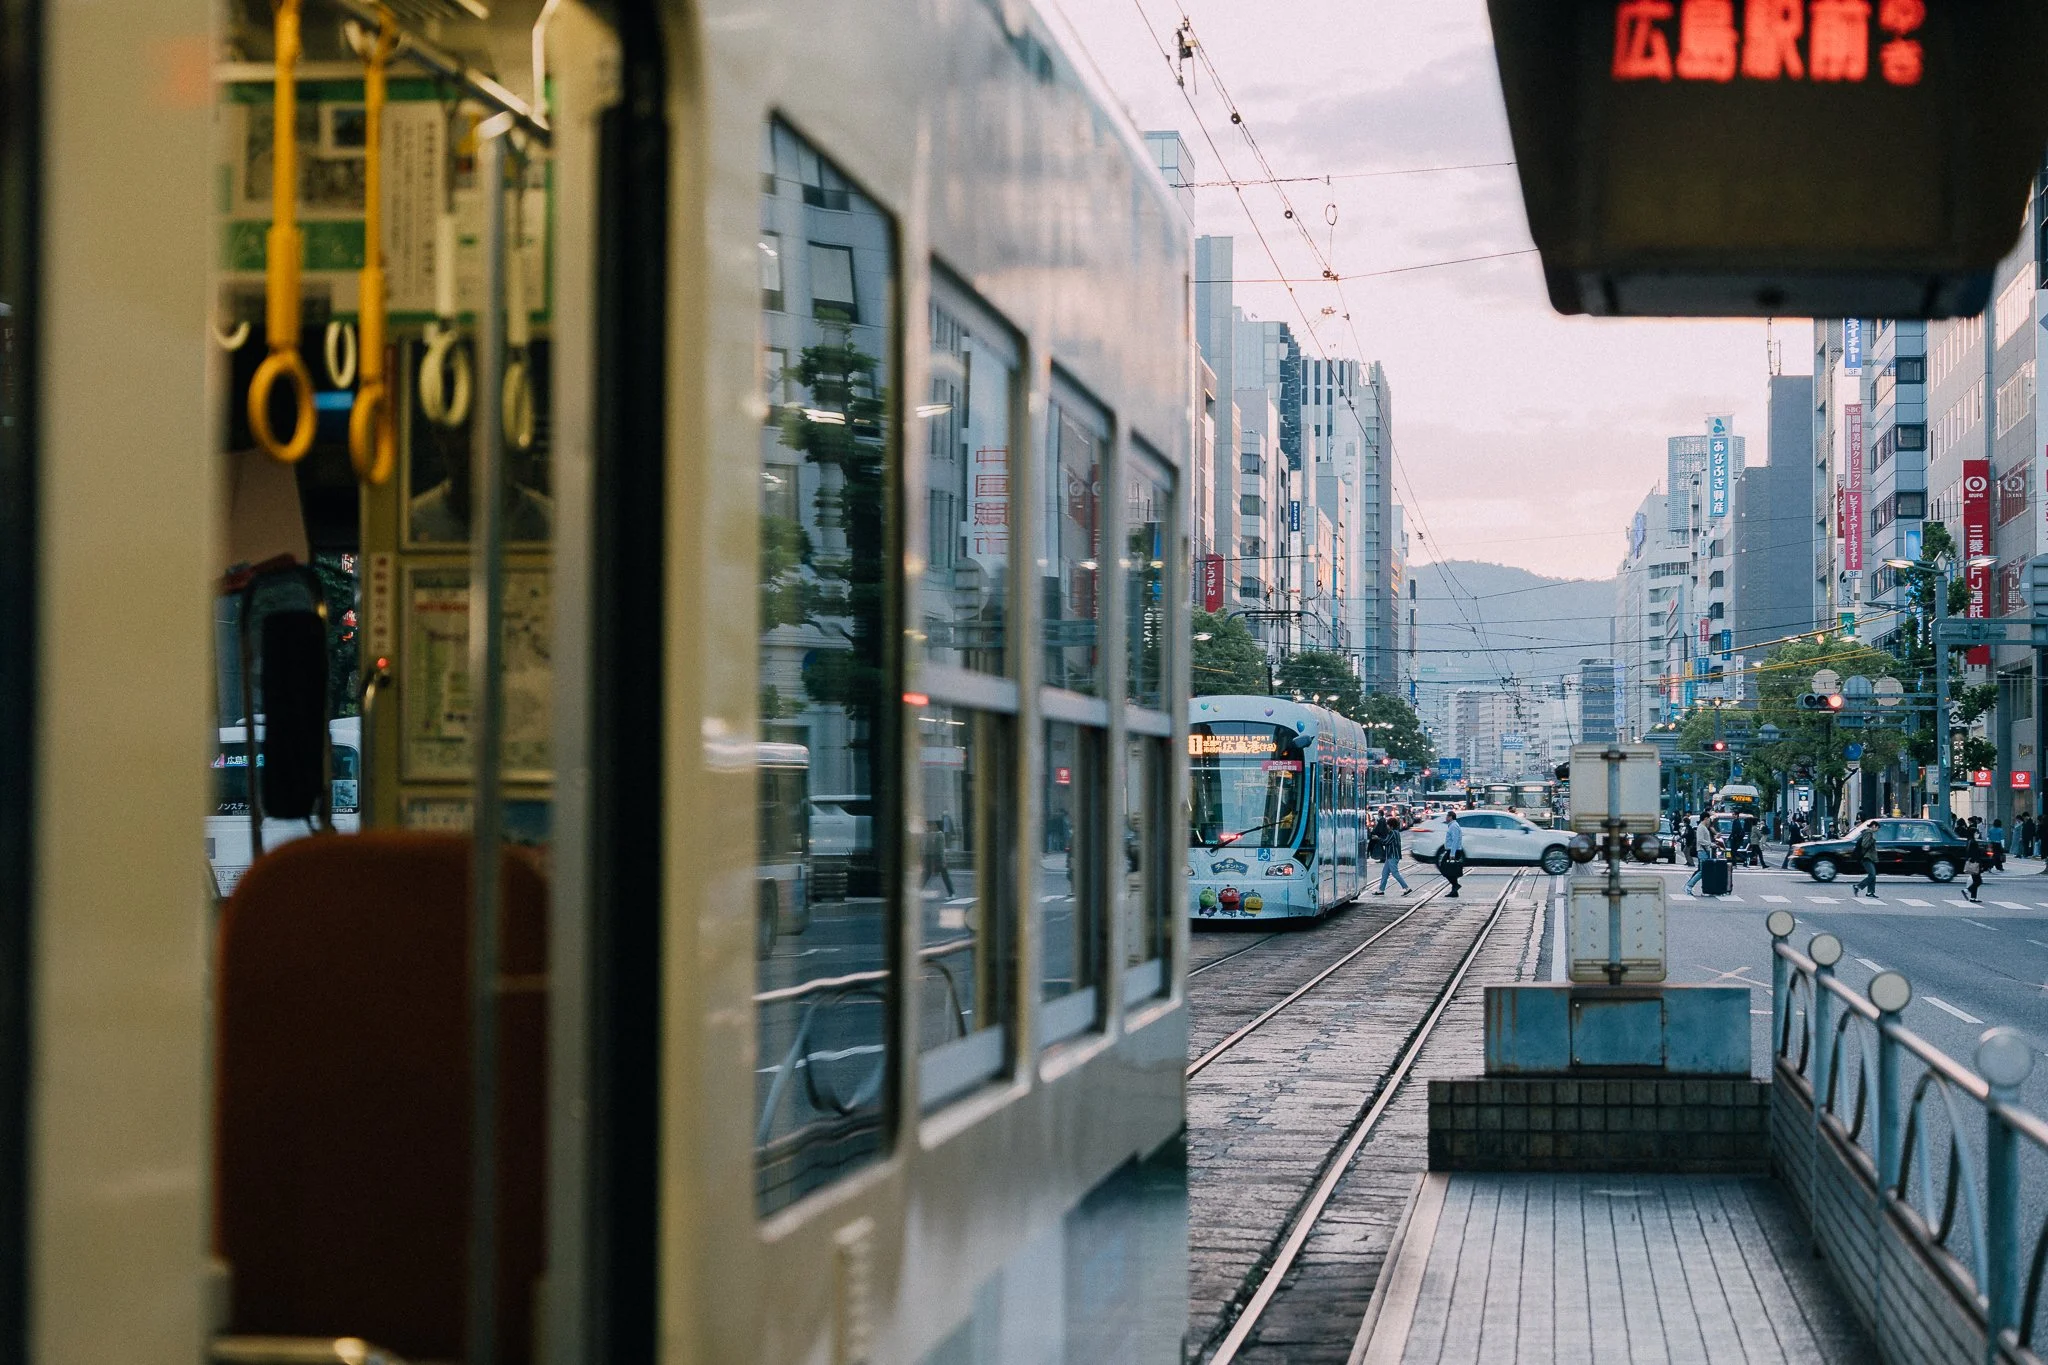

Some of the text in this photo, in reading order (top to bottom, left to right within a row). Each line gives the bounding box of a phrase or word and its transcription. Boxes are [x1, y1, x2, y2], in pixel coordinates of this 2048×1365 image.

[1713, 440, 1725, 514] あなぶき興産
[1851, 414, 1861, 489] 湘南美容クリニック
[1969, 524, 1984, 618] 三菱FJ信託
